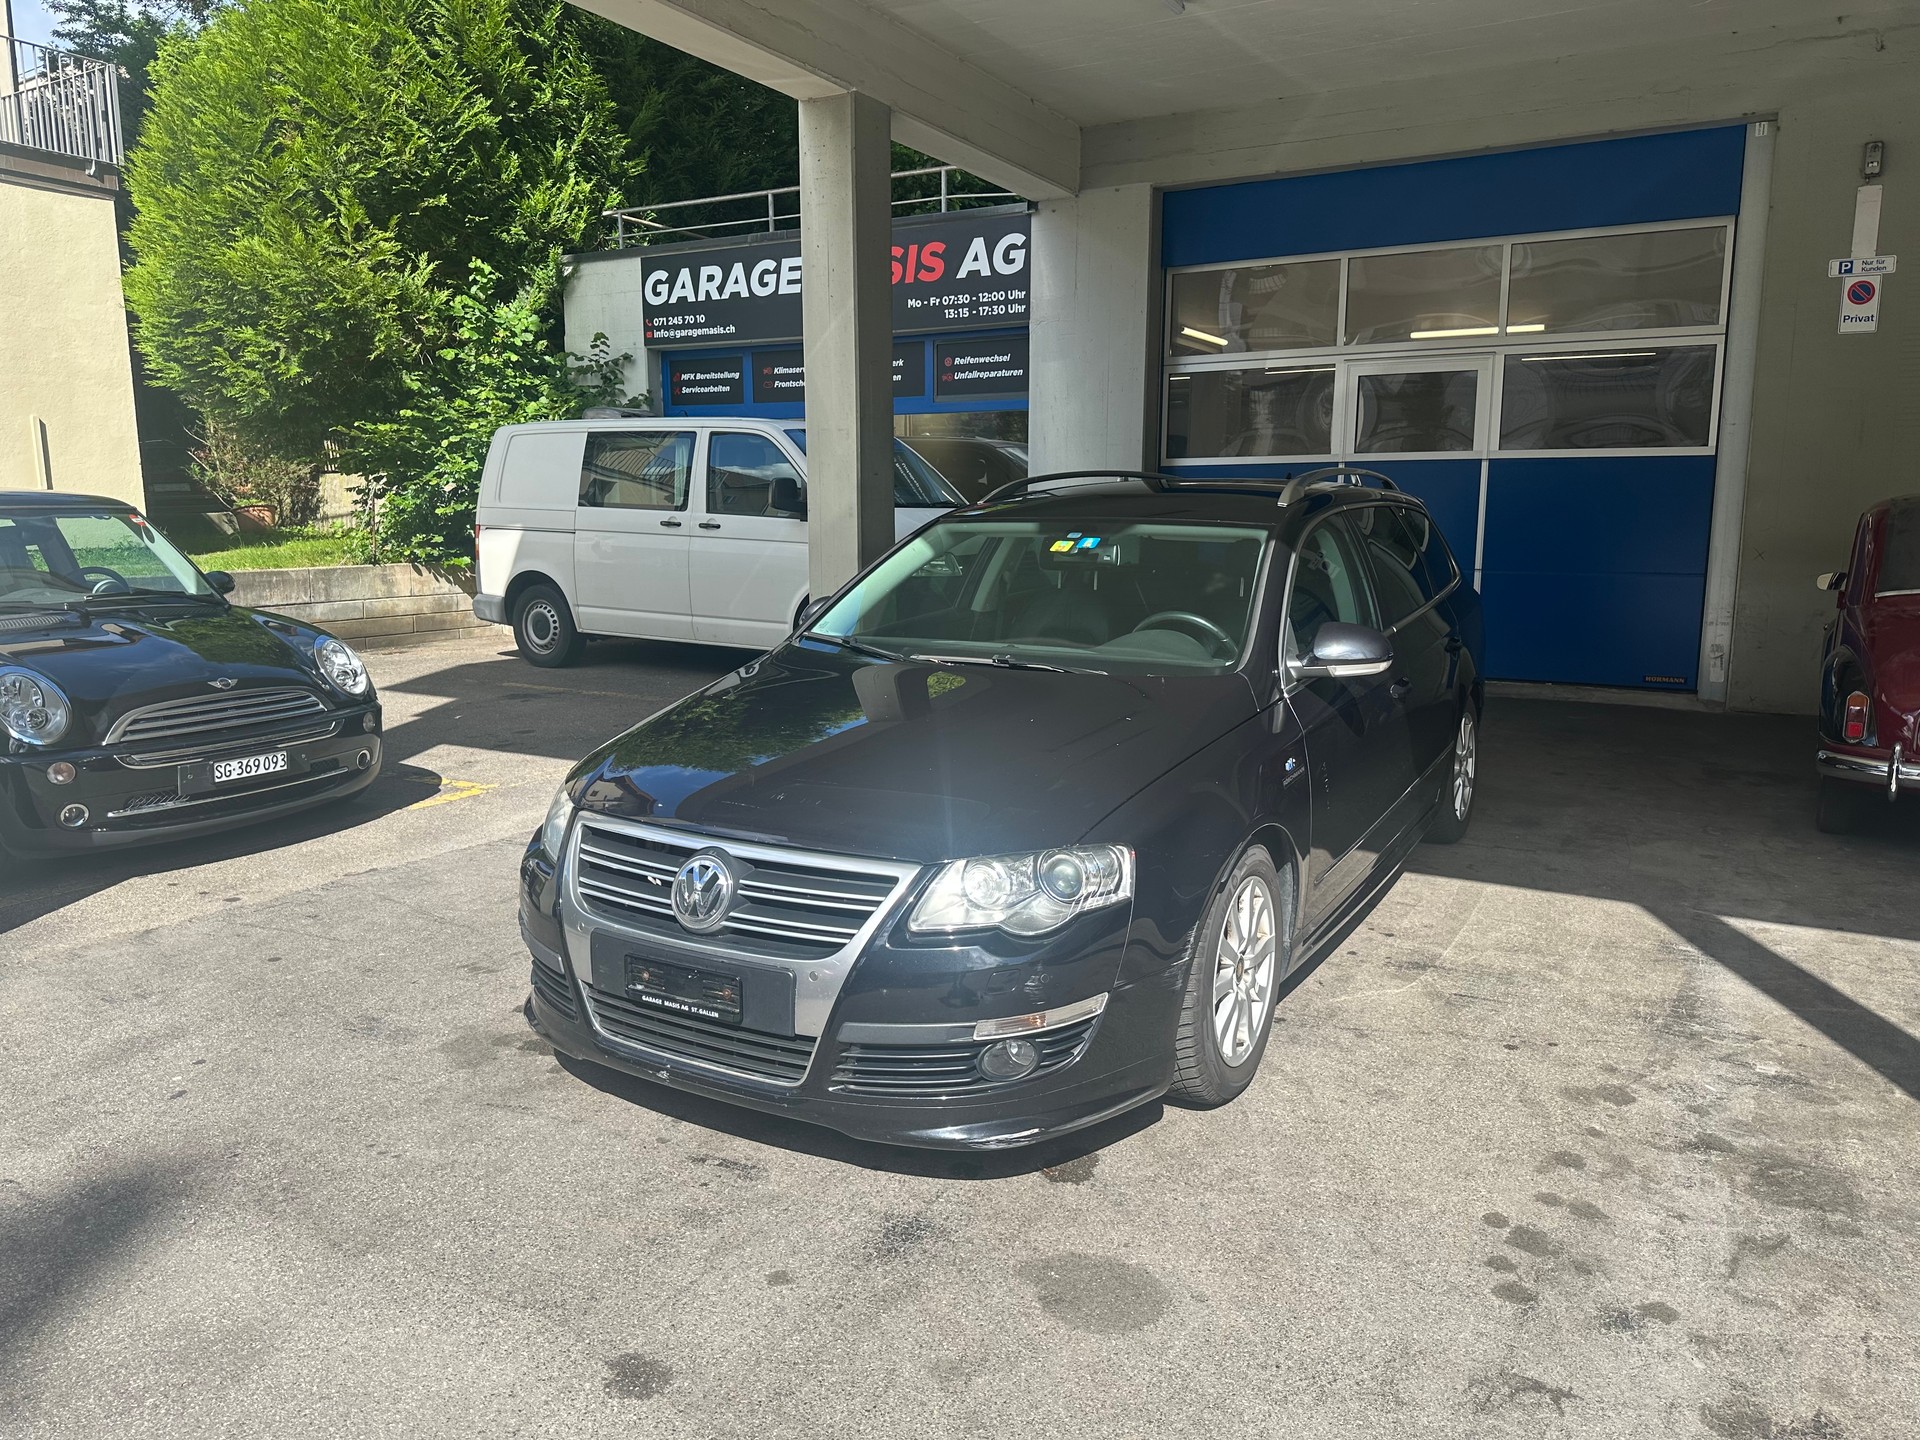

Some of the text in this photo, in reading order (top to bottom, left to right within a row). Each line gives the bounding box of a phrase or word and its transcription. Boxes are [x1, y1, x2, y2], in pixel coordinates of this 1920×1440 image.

[644, 257, 802, 306] GARAGE
[956, 232, 1027, 279] AG
[1841, 262, 1851, 273] P
[907, 298, 922, 309] Mo
[930, 297, 940, 307] Fr
[942, 294, 971, 306] 07:30
[978, 291, 1005, 303] 12:00
[1008, 289, 1027, 300] Uhr
[944, 308, 970, 319] 13:15
[978, 305, 1006, 316] 17:30
[1008, 303, 1027, 314] Uhr
[653, 314, 706, 326] 071 245 70 10
[1843, 314, 1875, 323] Privat
[653, 324, 736, 339] info@garagemasis.ch
[954, 353, 1011, 365] Reifenwechsel
[681, 371, 740, 381] MFK Bereitstellung
[954, 369, 1023, 380] Unfallreparaturen
[681, 384, 730, 394] Servicearbeiten
[263, 753, 287, 771] 093
[641, 995, 662, 1005] GARAGE
[664, 1000, 681, 1009] MASIS
